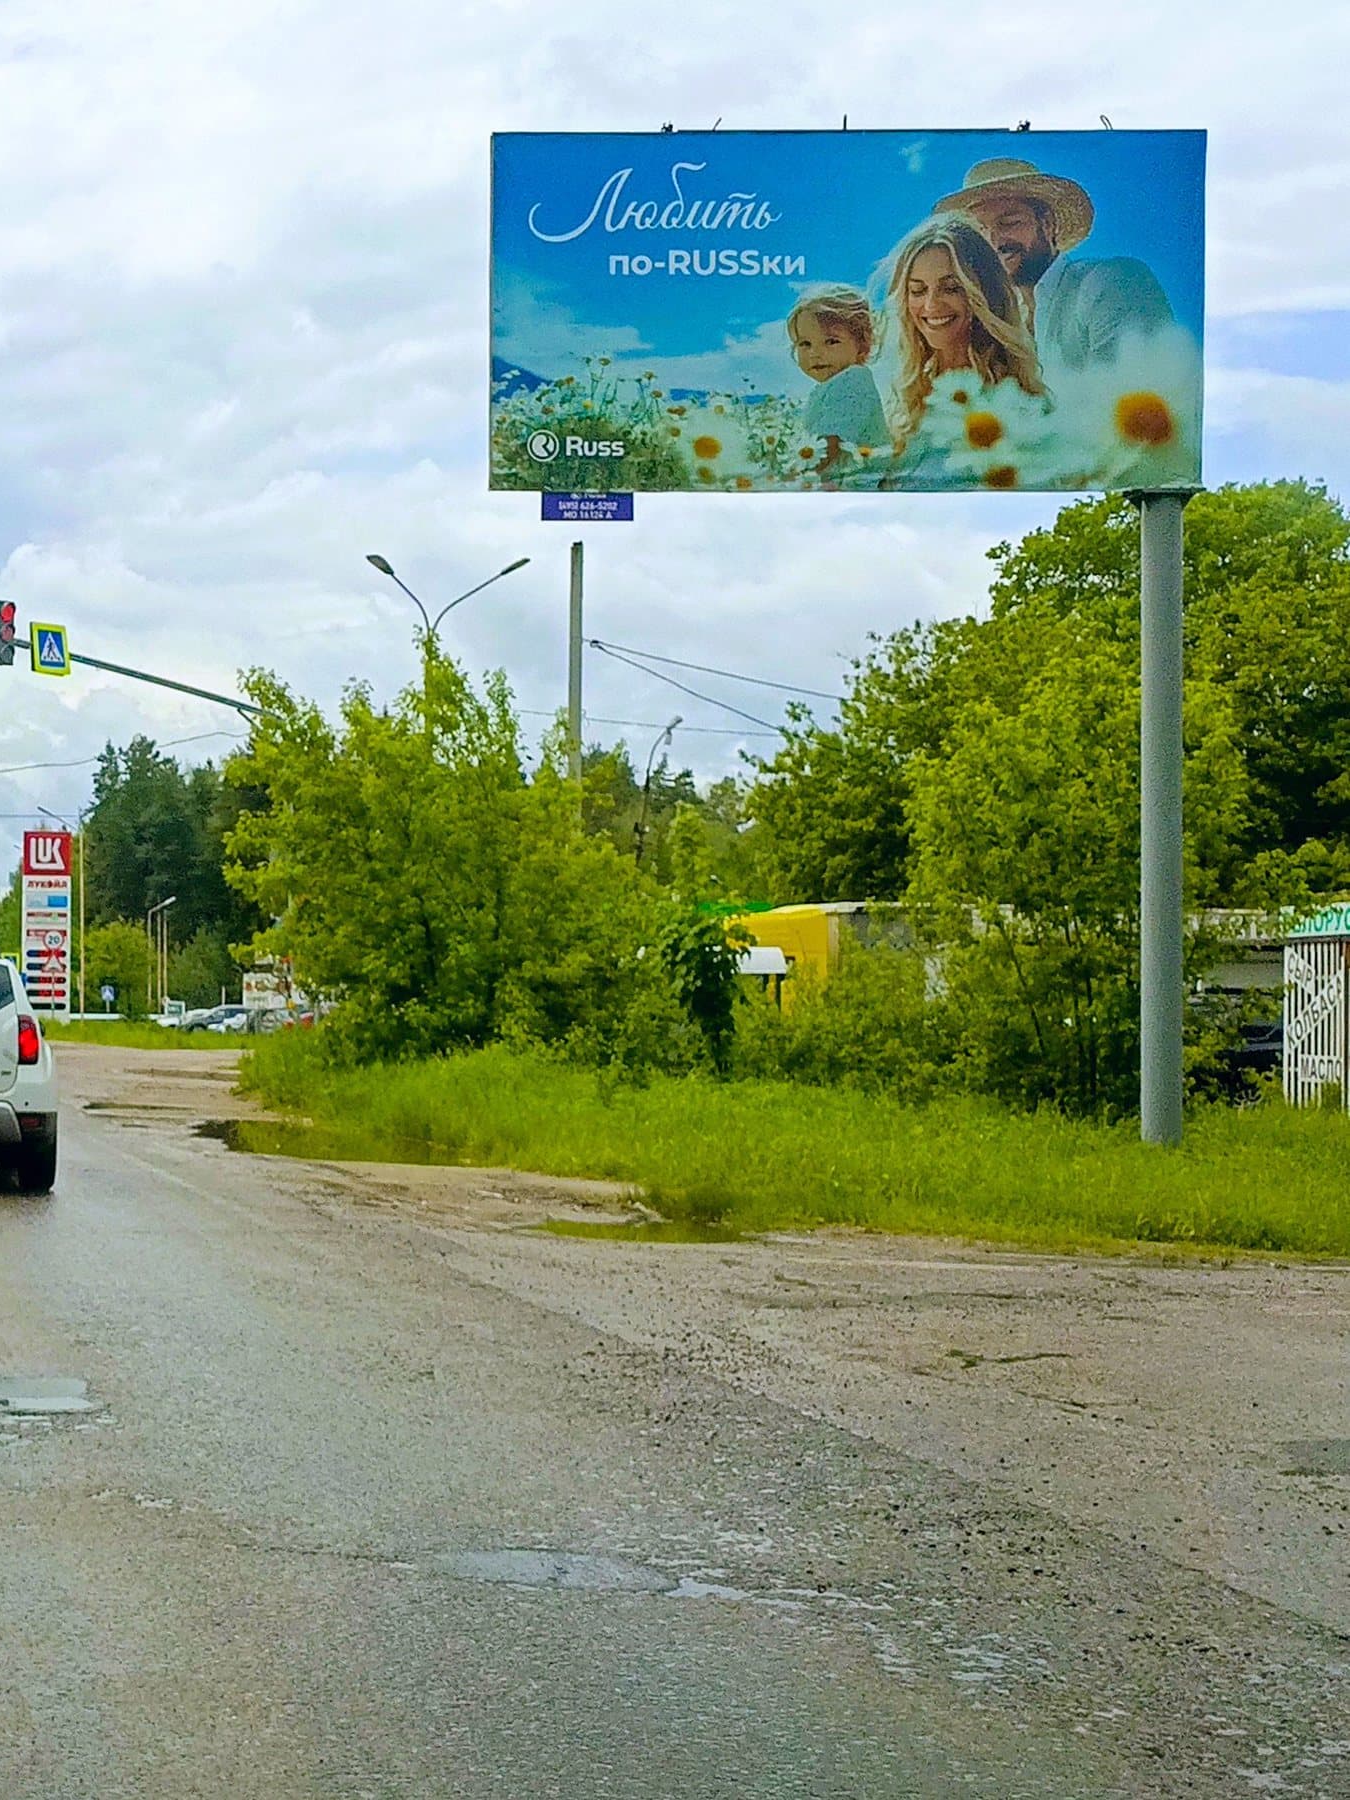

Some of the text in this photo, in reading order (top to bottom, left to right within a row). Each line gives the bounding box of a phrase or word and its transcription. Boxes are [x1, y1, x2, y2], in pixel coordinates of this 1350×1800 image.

[528, 162, 782, 242] Любить
[609, 249, 805, 276] по-RUSSки
[565, 436, 625, 457] Russ
[1286, 952, 1313, 987] СЫР
[1300, 1056, 1342, 1081] МАСЛО
